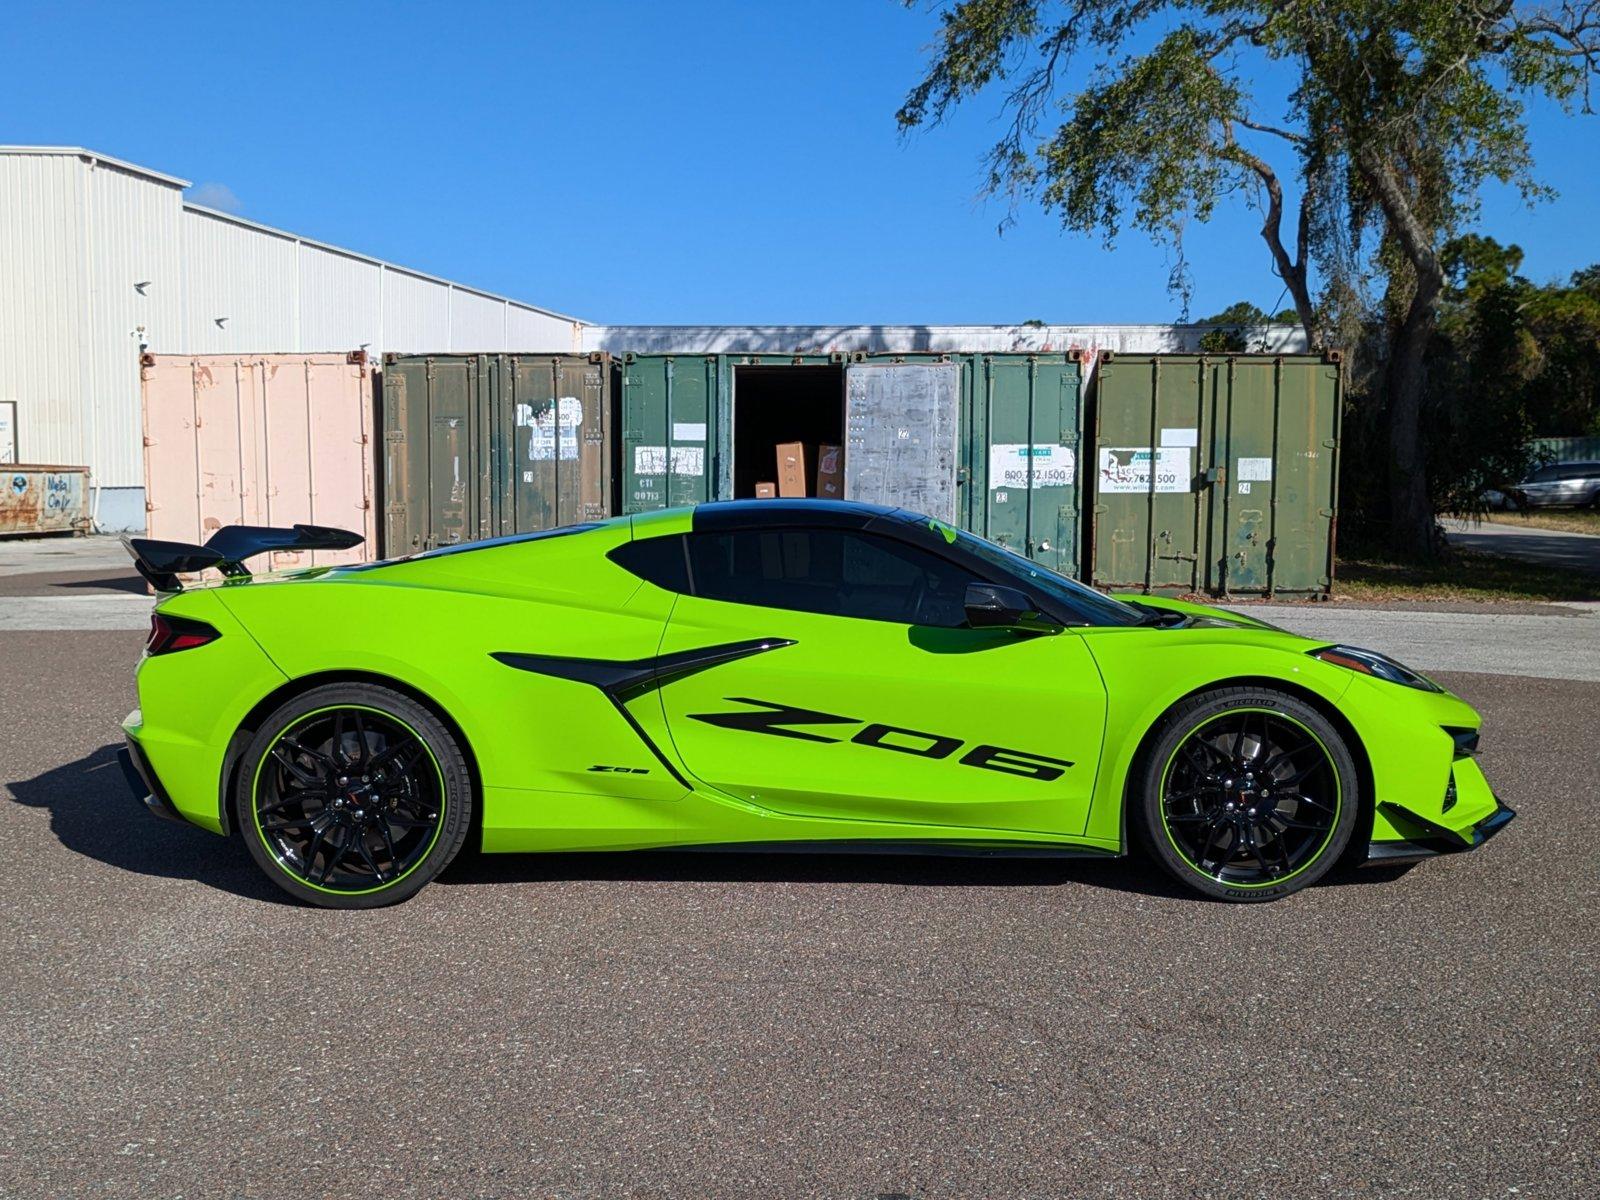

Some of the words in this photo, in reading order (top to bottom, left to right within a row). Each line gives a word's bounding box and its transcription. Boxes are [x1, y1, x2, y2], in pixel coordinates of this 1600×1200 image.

[1240, 484, 1249, 494] 24
[48, 493, 70, 512] Only
[686, 697, 1075, 782] Z06
